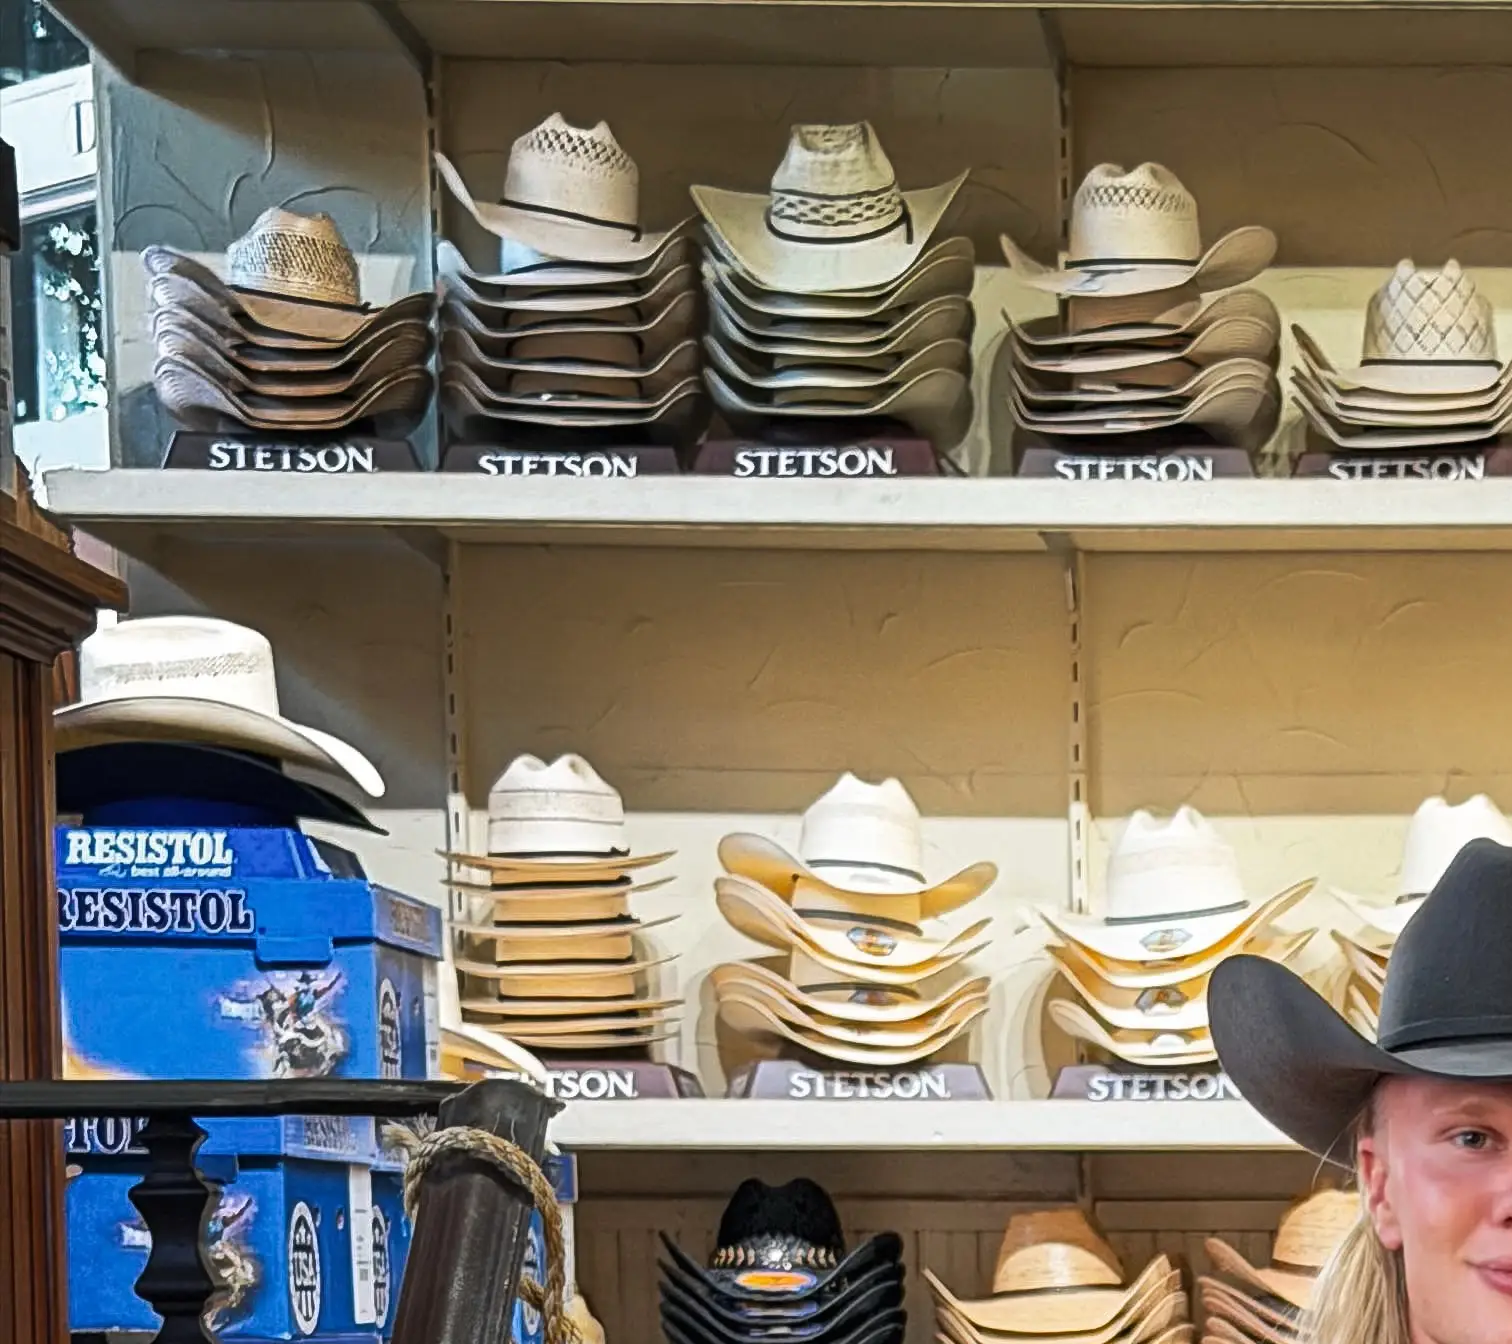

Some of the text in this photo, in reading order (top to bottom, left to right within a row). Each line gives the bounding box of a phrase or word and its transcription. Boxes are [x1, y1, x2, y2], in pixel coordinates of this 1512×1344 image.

[208, 442, 376, 473] STETSON
[478, 455, 637, 477] STETSON
[735, 447, 897, 478] STETSON
[1054, 456, 1214, 481] STETSON
[1328, 456, 1485, 480] STETSON
[65, 830, 234, 865] RESISTOL
[789, 1069, 952, 1100] STETSON
